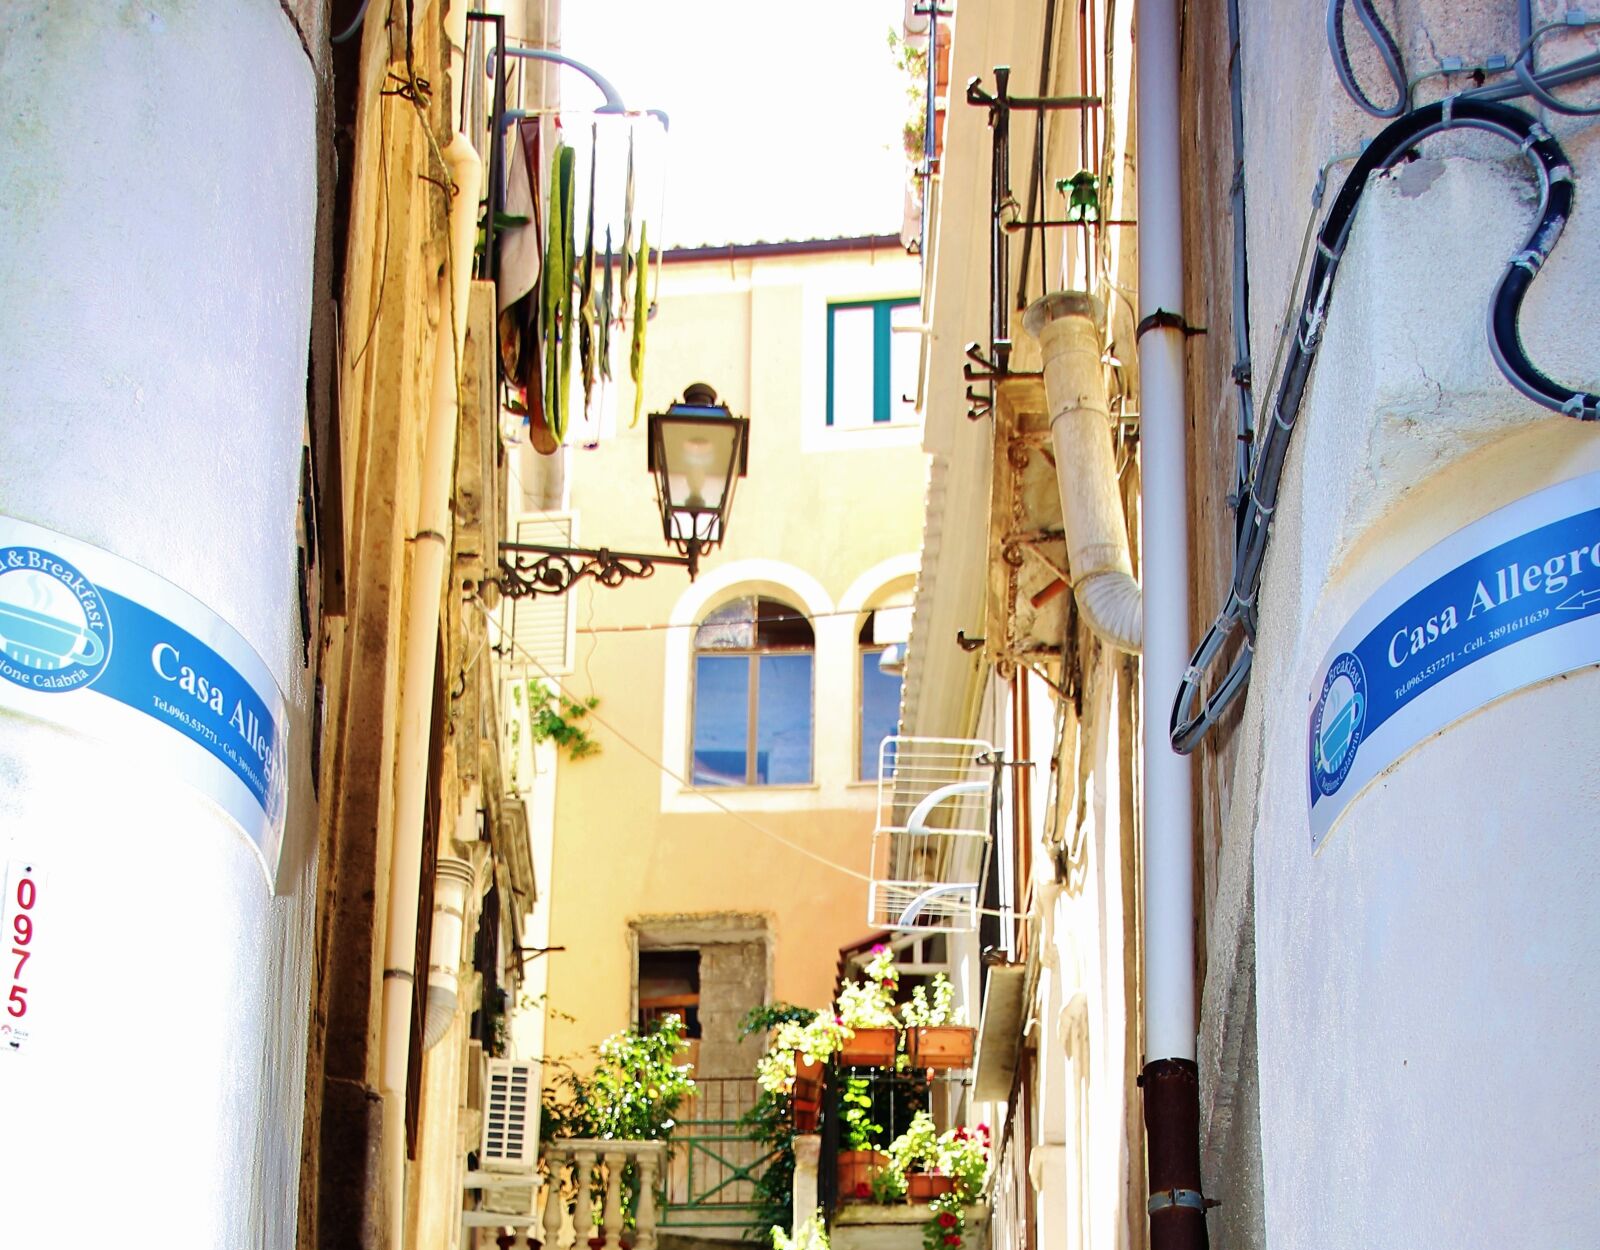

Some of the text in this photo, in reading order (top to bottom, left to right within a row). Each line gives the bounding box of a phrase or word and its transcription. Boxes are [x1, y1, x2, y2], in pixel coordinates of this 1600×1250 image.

[7, 550, 104, 630] & Breakfast
[1387, 604, 1459, 668] Casa
[1463, 636, 1486, 654] Cell.
[1488, 607, 1550, 642] 3891611639
[0, 660, 89, 688] ione Calabria
[151, 642, 225, 716] Casa
[1328, 656, 1361, 690] Breakfast
[223, 743, 238, 762] Cell.
[1339, 731, 1360, 780] Calabria
[7, 878, 37, 1018] 0975
